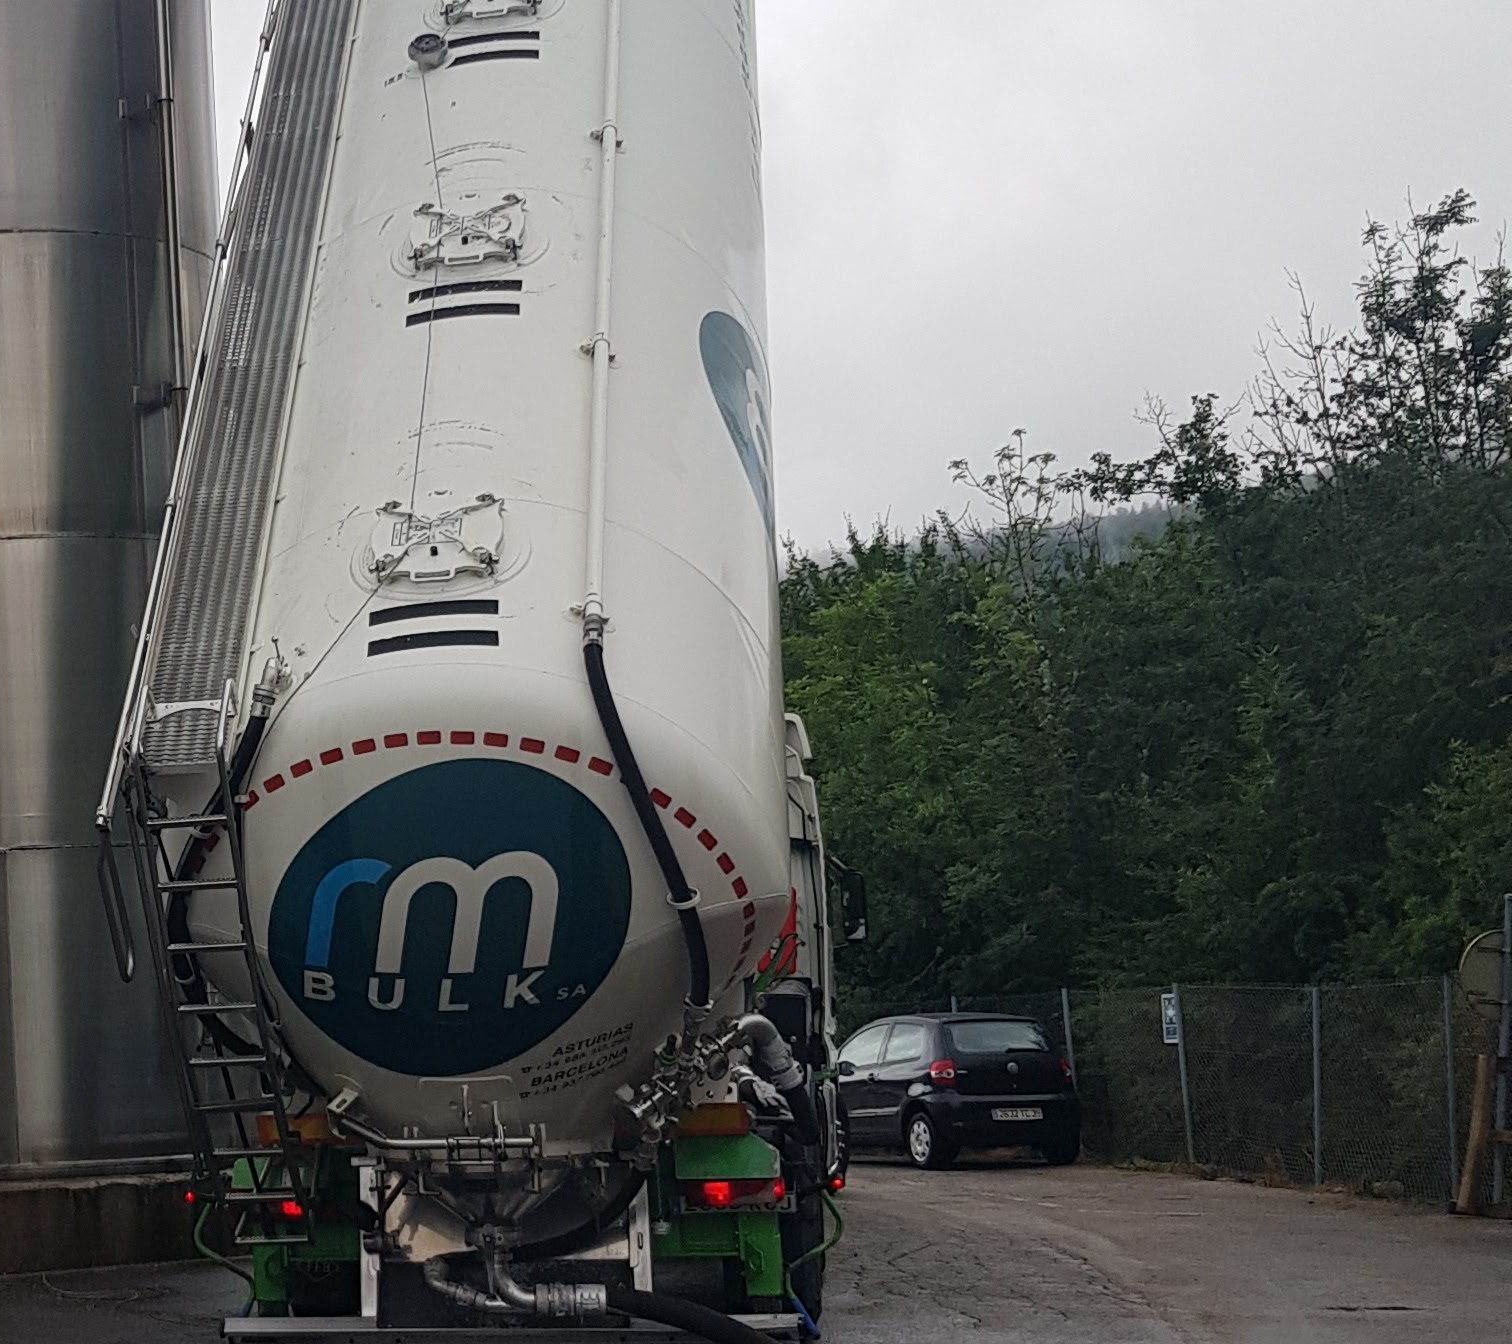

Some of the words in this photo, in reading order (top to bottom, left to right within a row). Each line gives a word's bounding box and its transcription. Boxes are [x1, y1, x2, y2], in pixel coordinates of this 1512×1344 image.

[304, 850, 559, 974] rm
[303, 969, 545, 1012] BULK
[556, 983, 587, 1001] SA
[552, 1022, 634, 1058] ASTURIAS
[531, 1046, 629, 1088] BARCELONA
